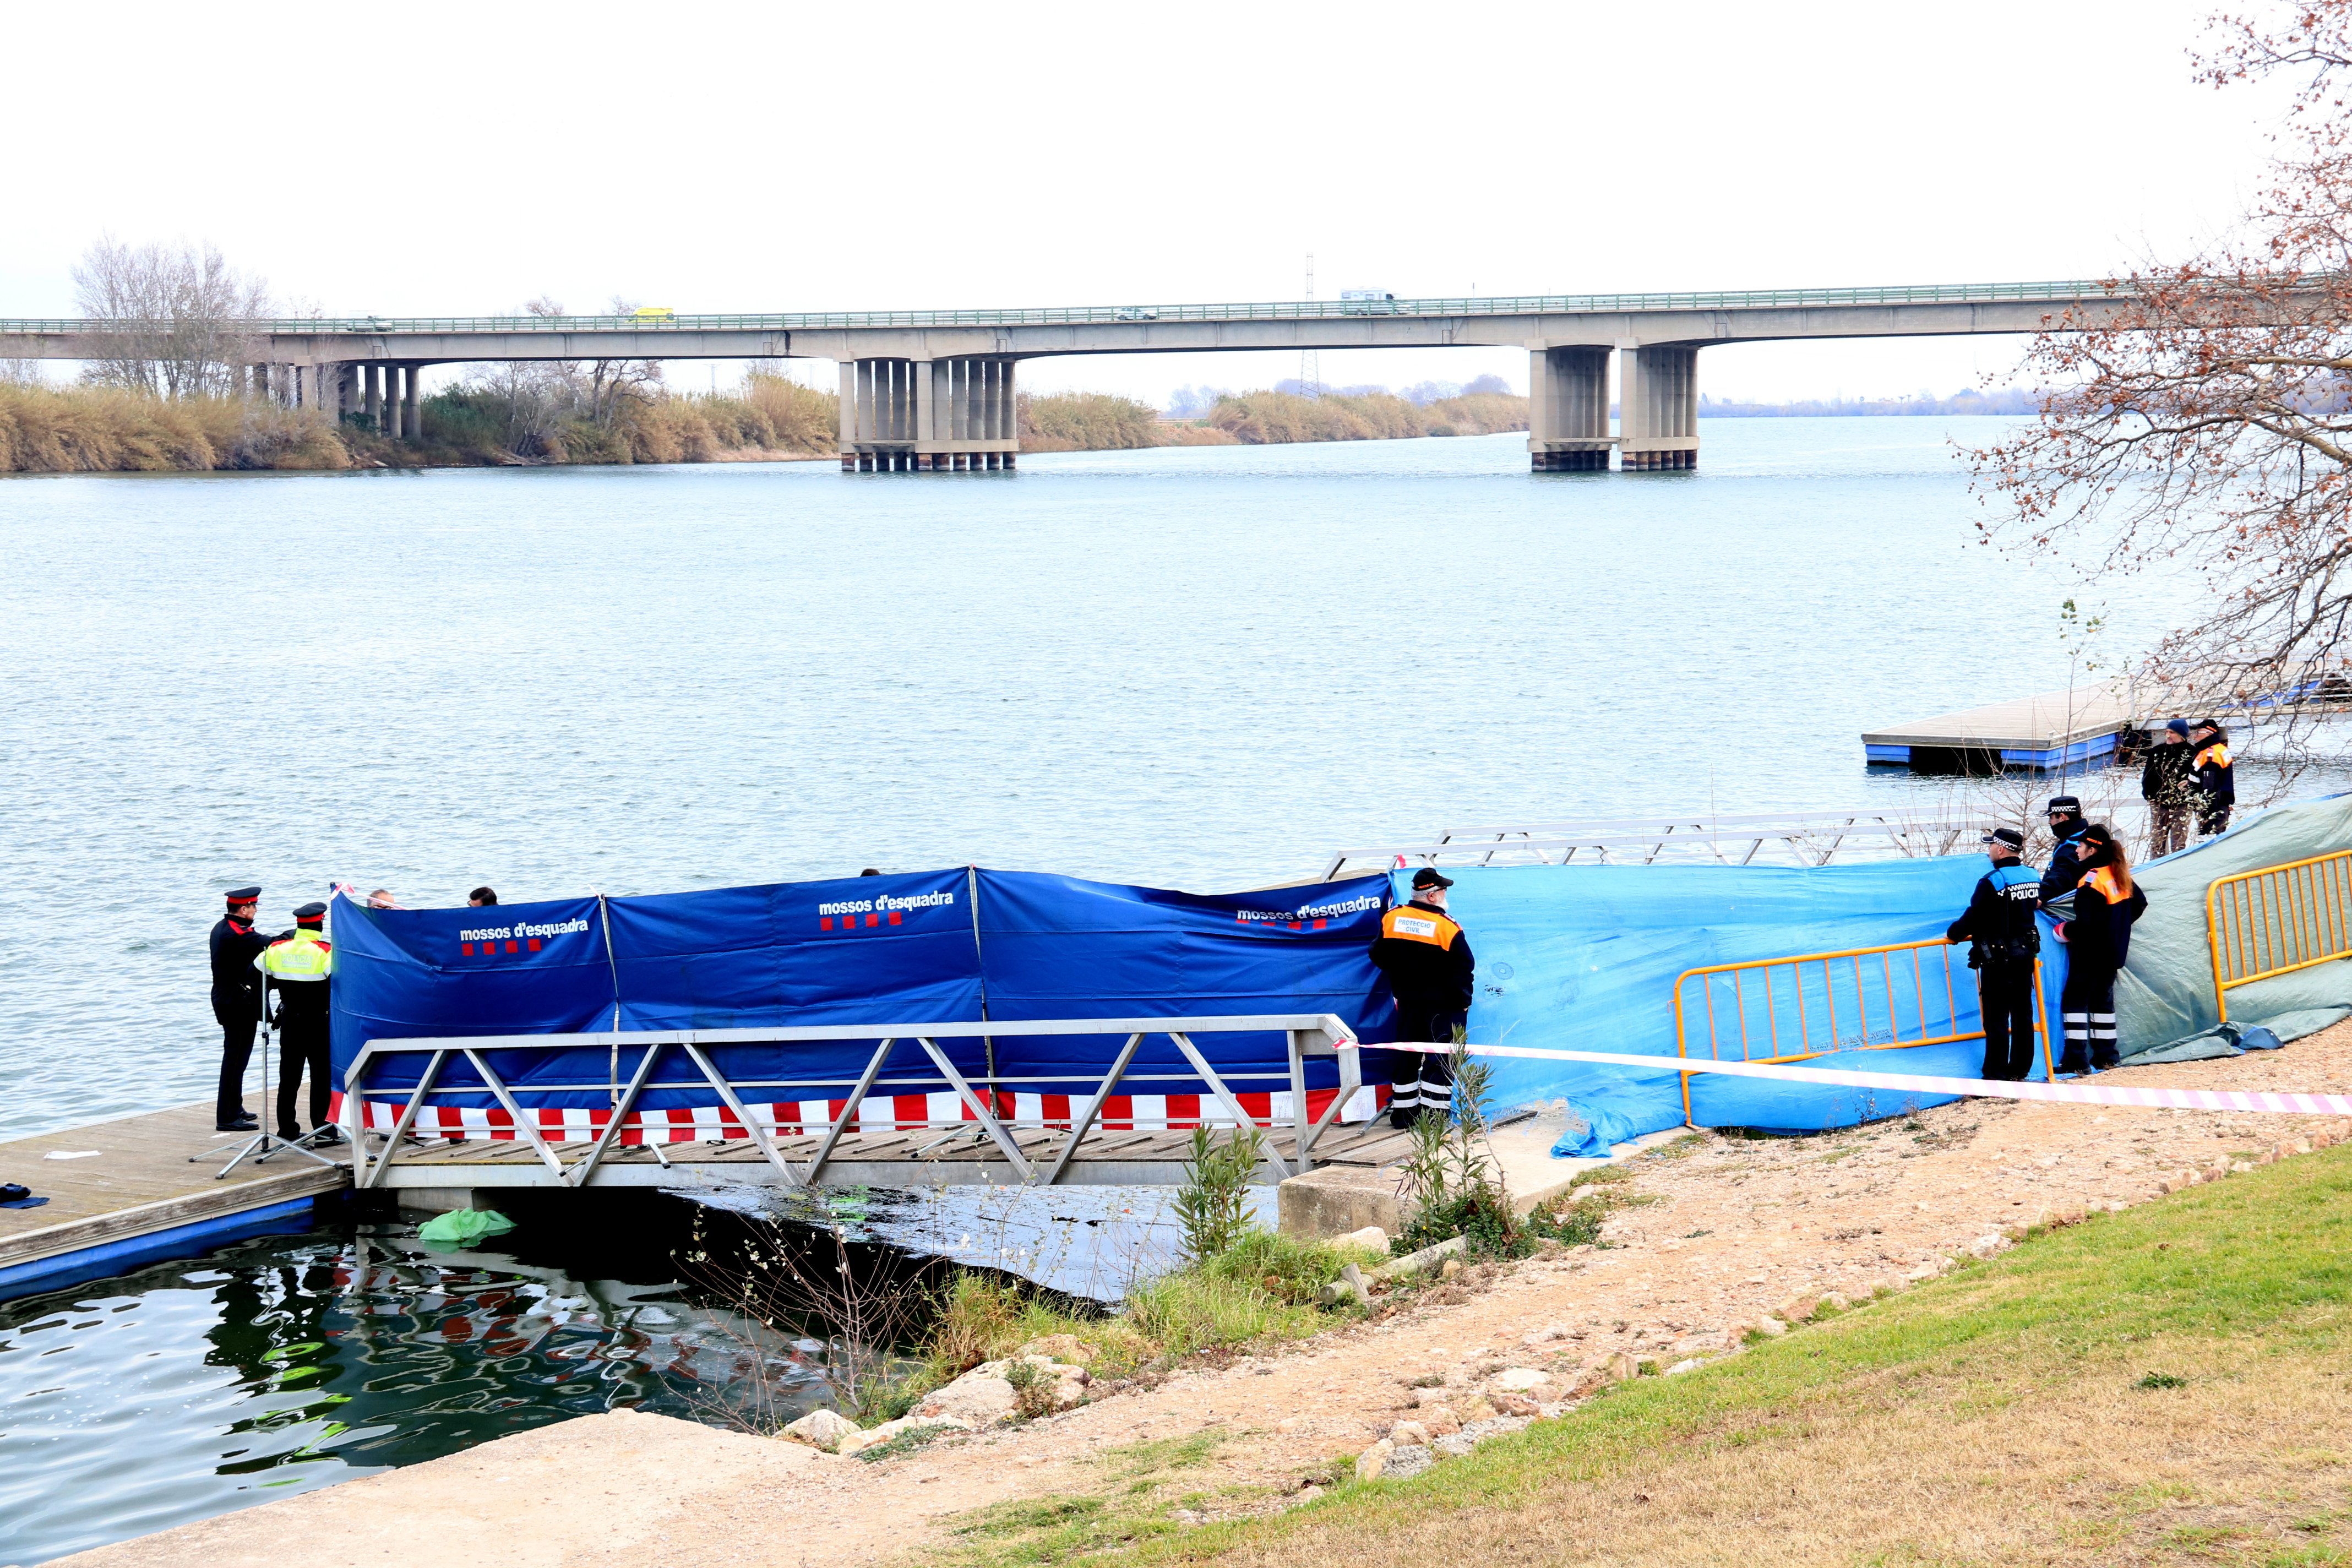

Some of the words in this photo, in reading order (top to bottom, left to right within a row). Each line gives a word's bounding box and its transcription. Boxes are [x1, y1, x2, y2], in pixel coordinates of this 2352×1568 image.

[819, 900, 872, 915] mossos
[875, 890, 954, 912] d'esquadra
[1237, 910, 1294, 920] mossos
[1297, 895, 1381, 919] d'esquadra
[460, 927, 511, 941] mossos
[514, 918, 589, 938] d'esquadra
